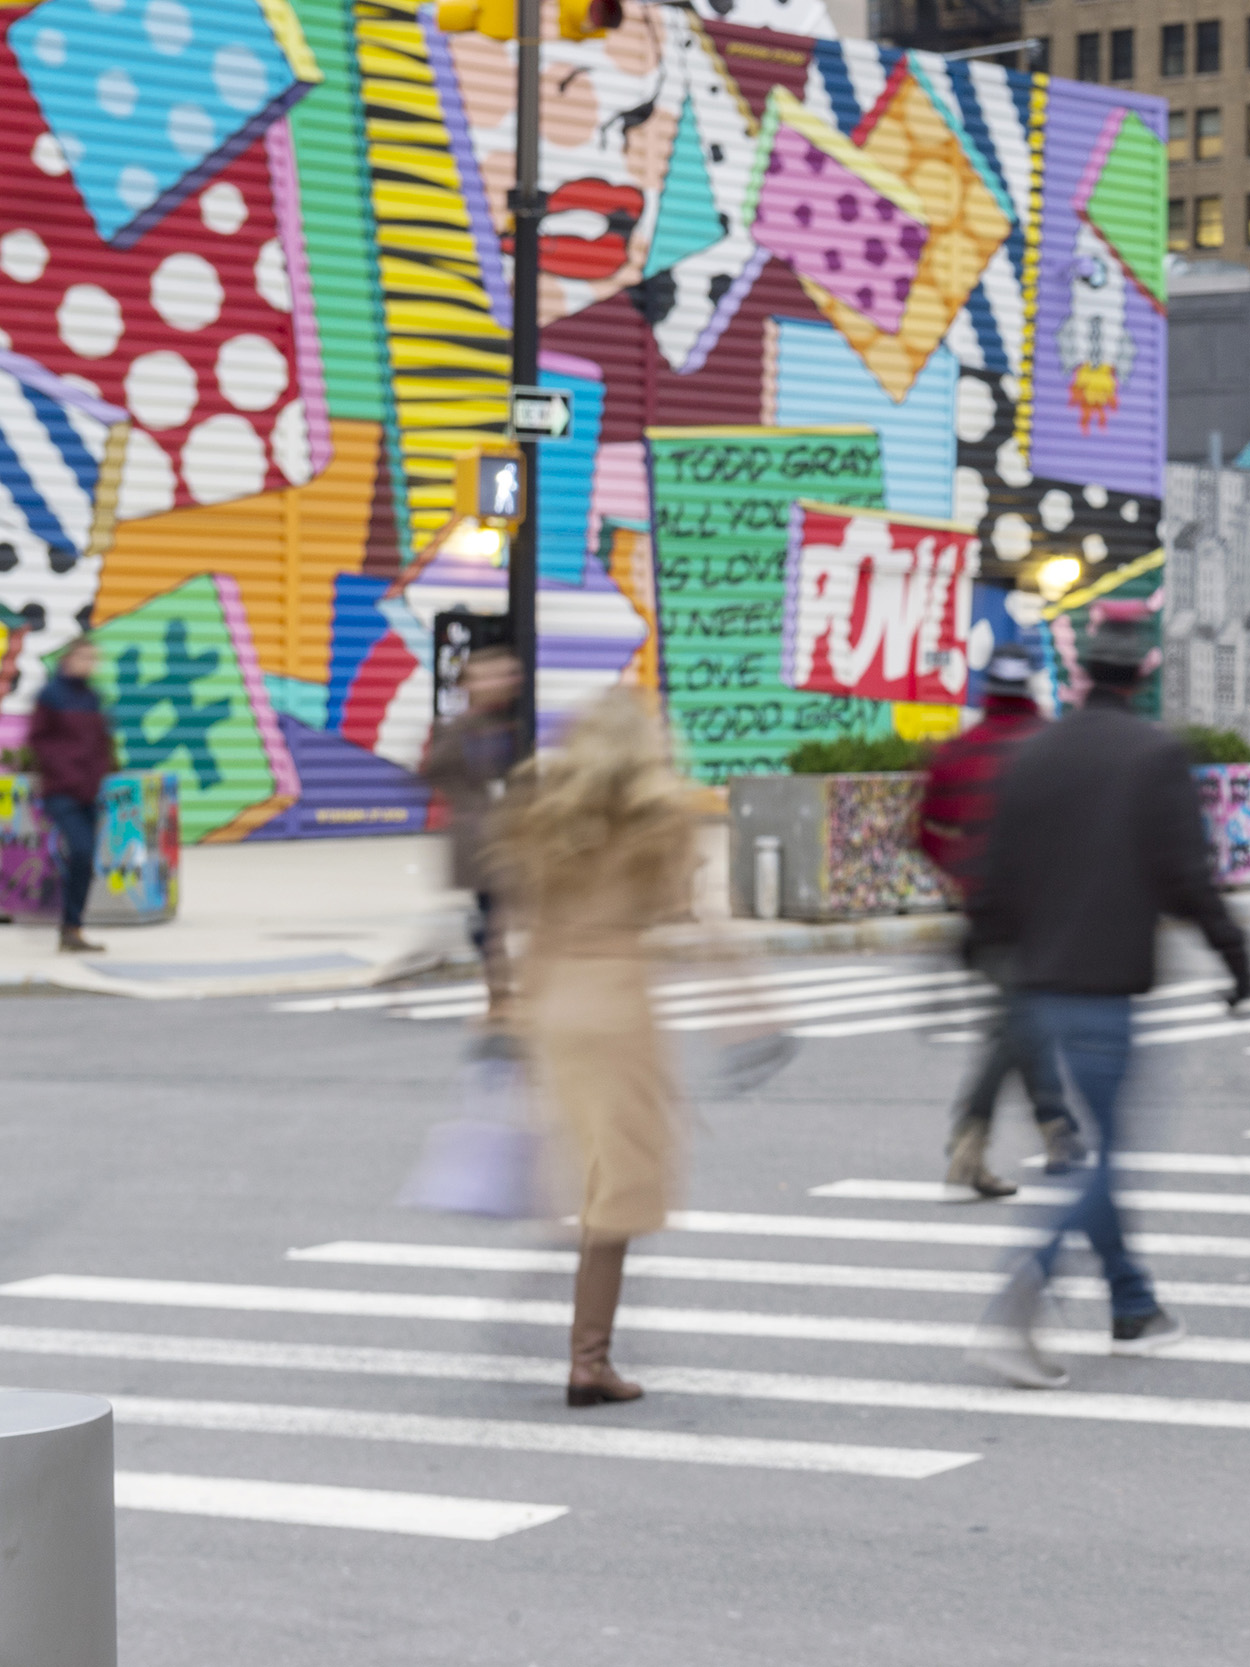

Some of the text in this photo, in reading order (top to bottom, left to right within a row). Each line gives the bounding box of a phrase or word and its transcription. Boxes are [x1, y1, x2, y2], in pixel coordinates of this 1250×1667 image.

[670, 444, 882, 484] TODD GRAY
[681, 701, 783, 743] TODD
